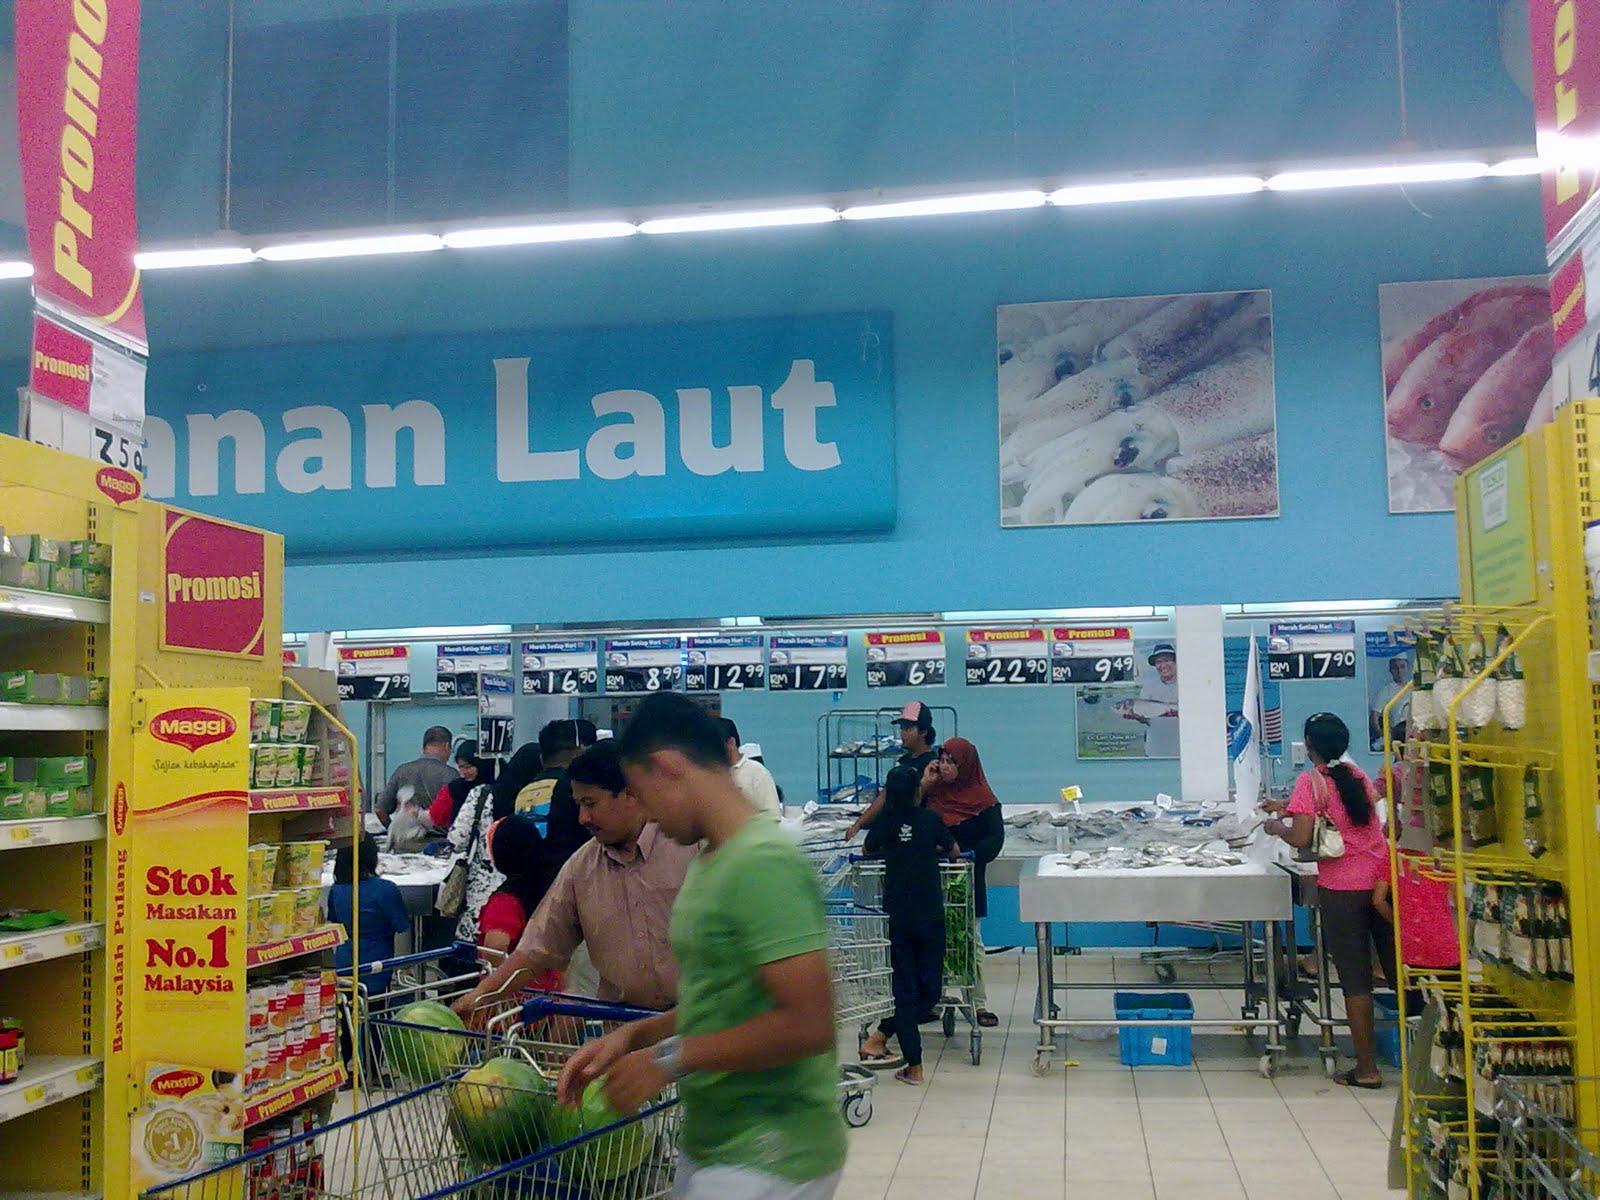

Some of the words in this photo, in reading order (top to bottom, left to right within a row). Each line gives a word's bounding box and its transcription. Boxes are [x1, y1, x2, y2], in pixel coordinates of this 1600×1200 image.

[34, 350, 90, 382] Promosi
[491, 357, 842, 482] Laut
[101, 474, 136, 495] Maggi
[168, 571, 261, 603] Promosi
[881, 632, 926, 643] Promosi
[984, 630, 1030, 640] Promosi
[1068, 629, 1115, 639] Promosi
[353, 647, 394, 658] Promosi
[160, 718, 226, 736] Maggi
[152, 759, 181, 773] Sajian
[146, 866, 237, 896] Stok
[114, 849, 128, 935] Pulang
[146, 903, 237, 920] Masakan
[144, 974, 234, 995] Malaysia
[113, 944, 124, 1053] Bawalah
[158, 1075, 199, 1091] Maggi
